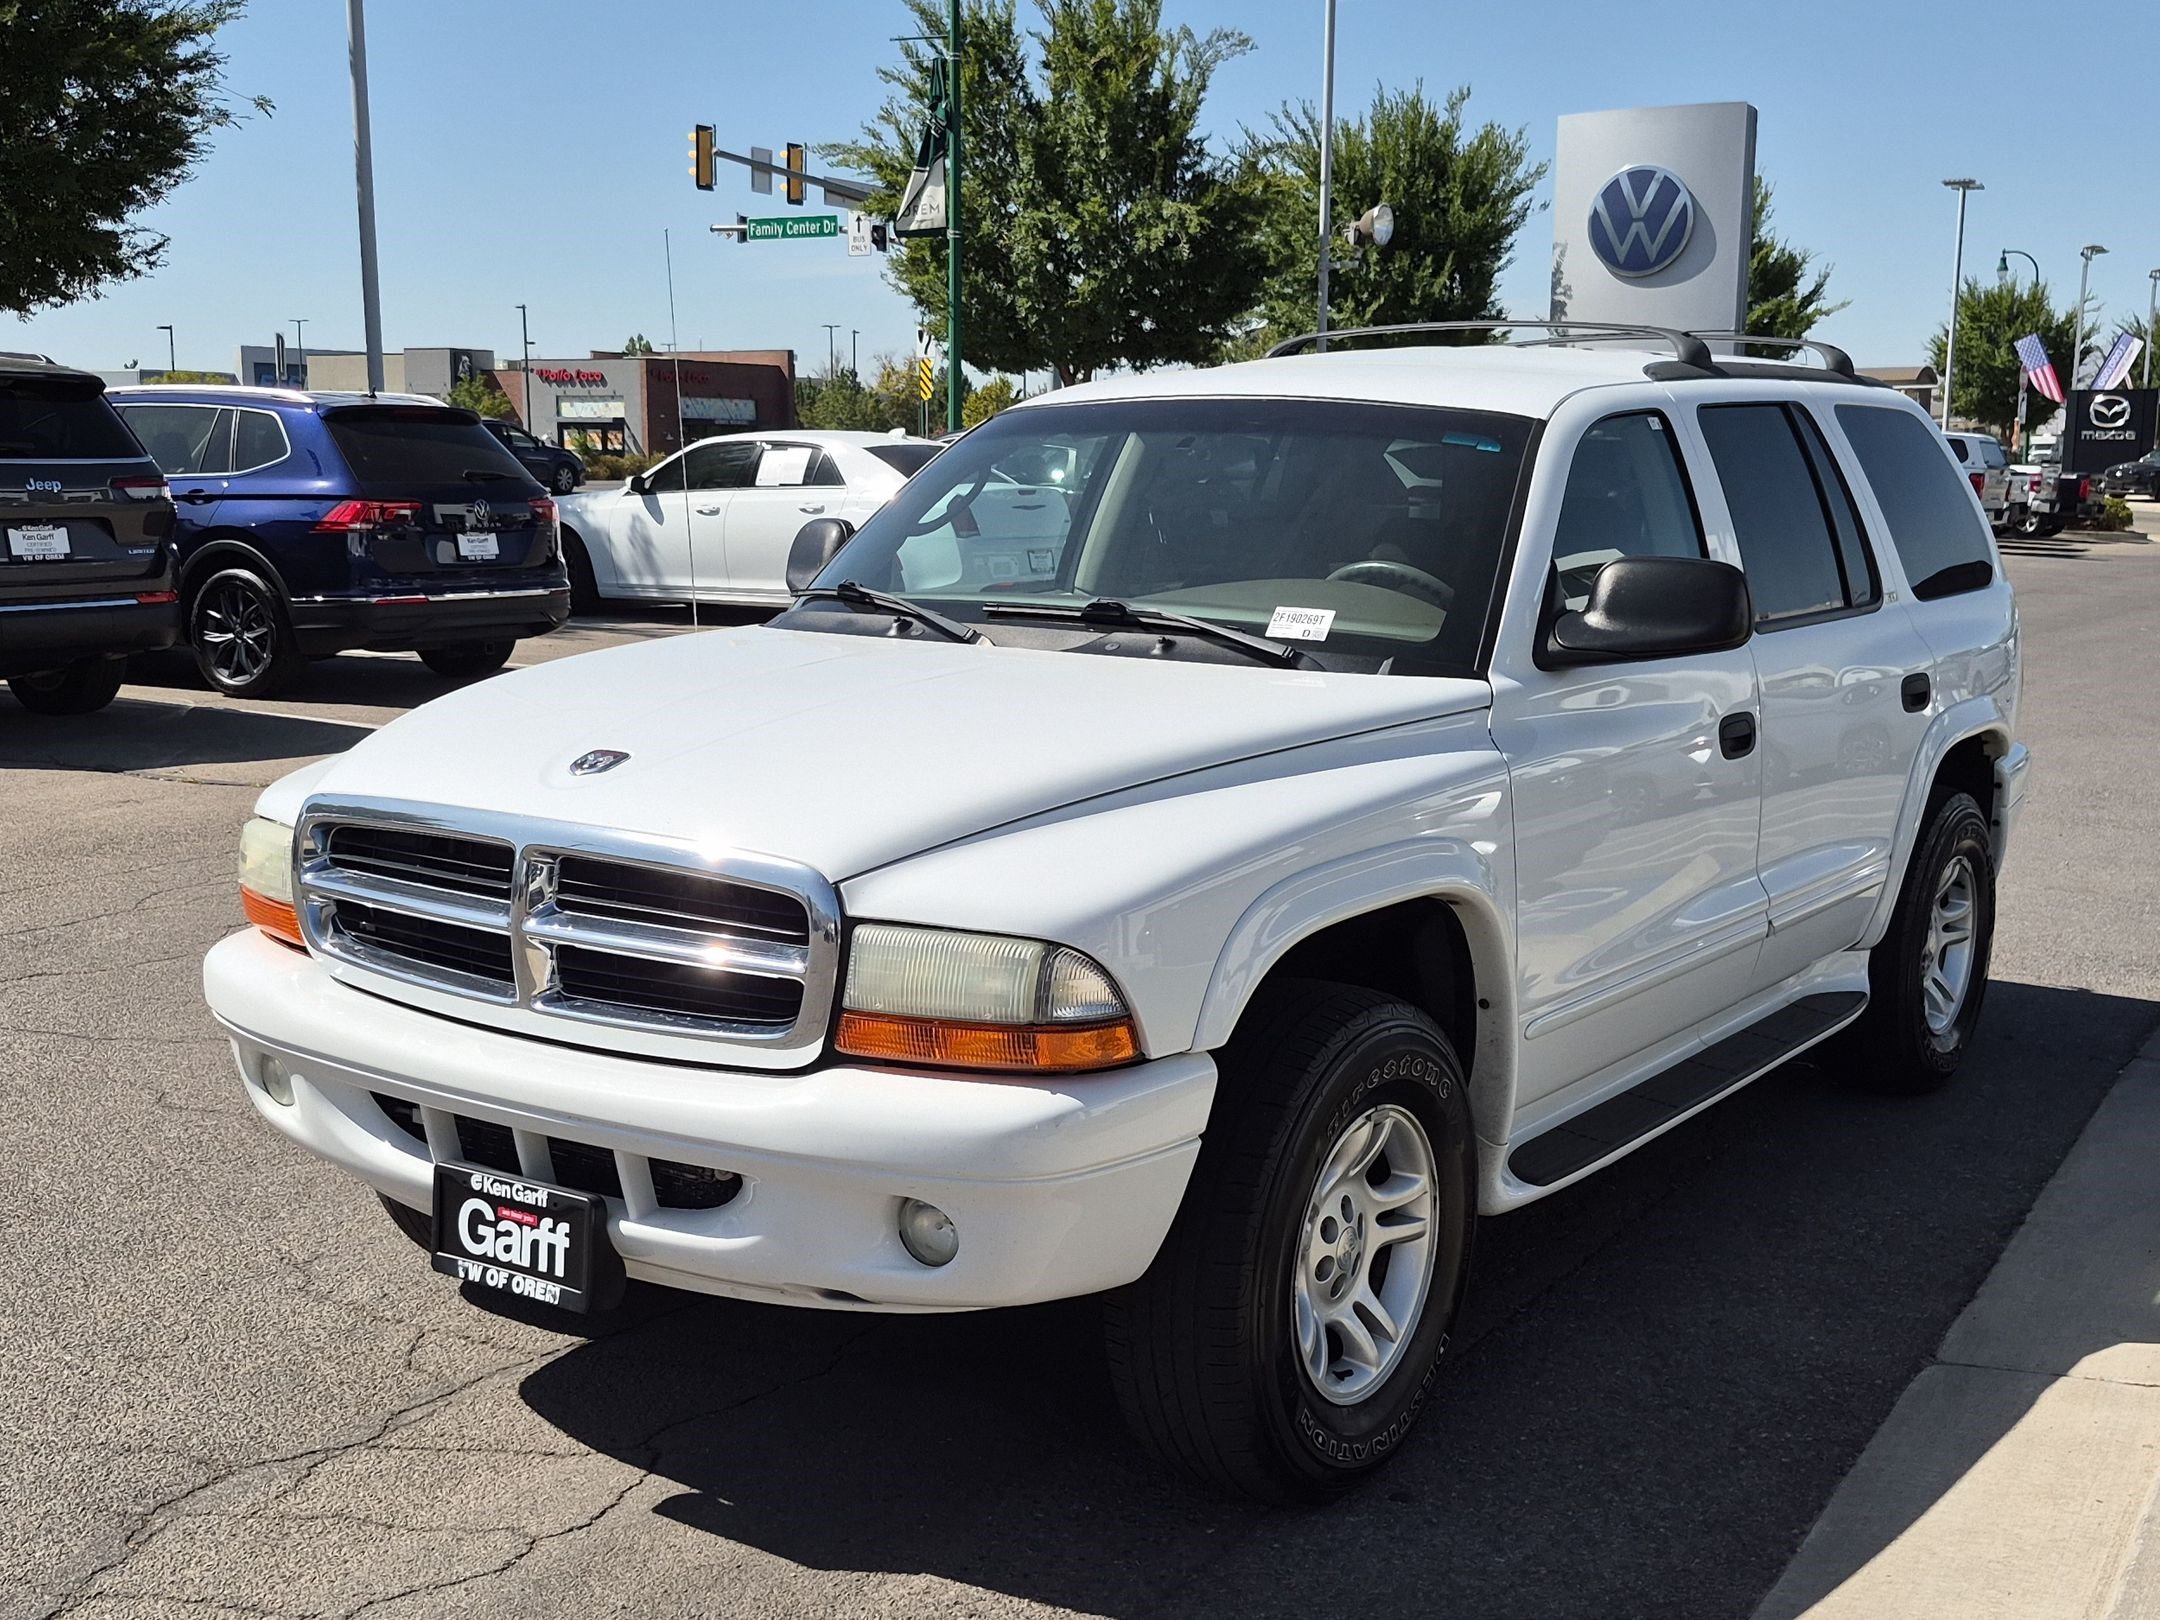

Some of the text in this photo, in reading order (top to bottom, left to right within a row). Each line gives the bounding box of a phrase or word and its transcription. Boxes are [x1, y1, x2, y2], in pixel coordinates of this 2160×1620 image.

[750, 219, 836, 238] Family Center Dr
[851, 244, 868, 252] ONLY
[26, 477, 62, 493] Jeep
[22, 533, 36, 541] Ken
[1273, 612, 1326, 625] 2F190269T
[483, 1175, 548, 1208] Ken Garff
[458, 1198, 570, 1278] Garff
[486, 1268, 509, 1289] OF
[1300, 1333, 1450, 1461] DESTINATION
